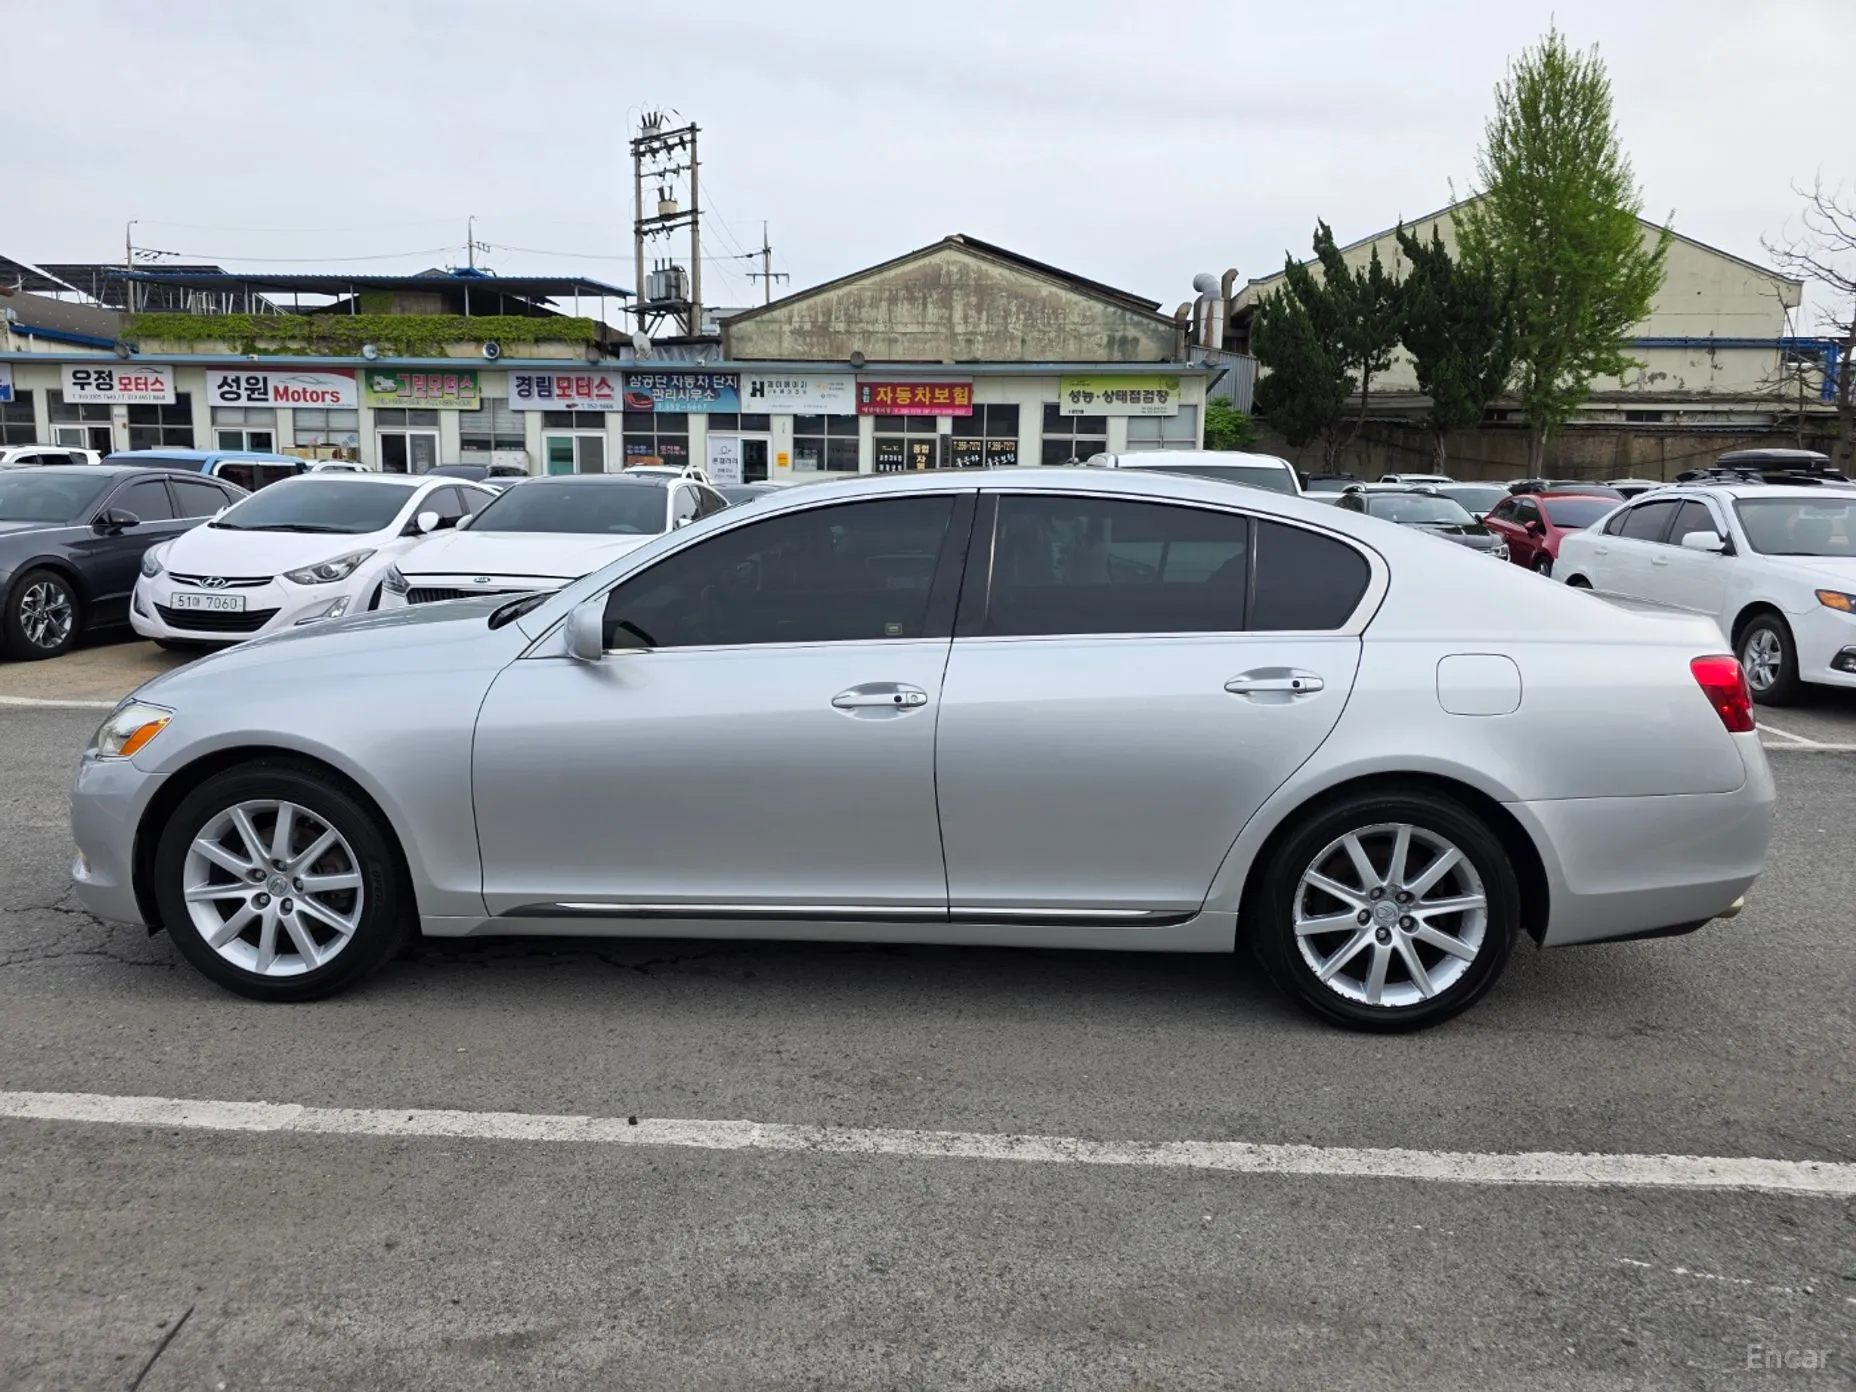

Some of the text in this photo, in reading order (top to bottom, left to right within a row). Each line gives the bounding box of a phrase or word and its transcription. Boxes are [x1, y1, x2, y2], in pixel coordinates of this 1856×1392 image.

[72, 370, 165, 392] 우정 모터스
[217, 375, 341, 403] 성원 Motors
[671, 375, 709, 388] 자동차
[713, 375, 737, 389] 단지
[652, 389, 716, 402] 관리사무소
[876, 386, 969, 405] 자동차보험
[206, 596, 237, 610] 7060
